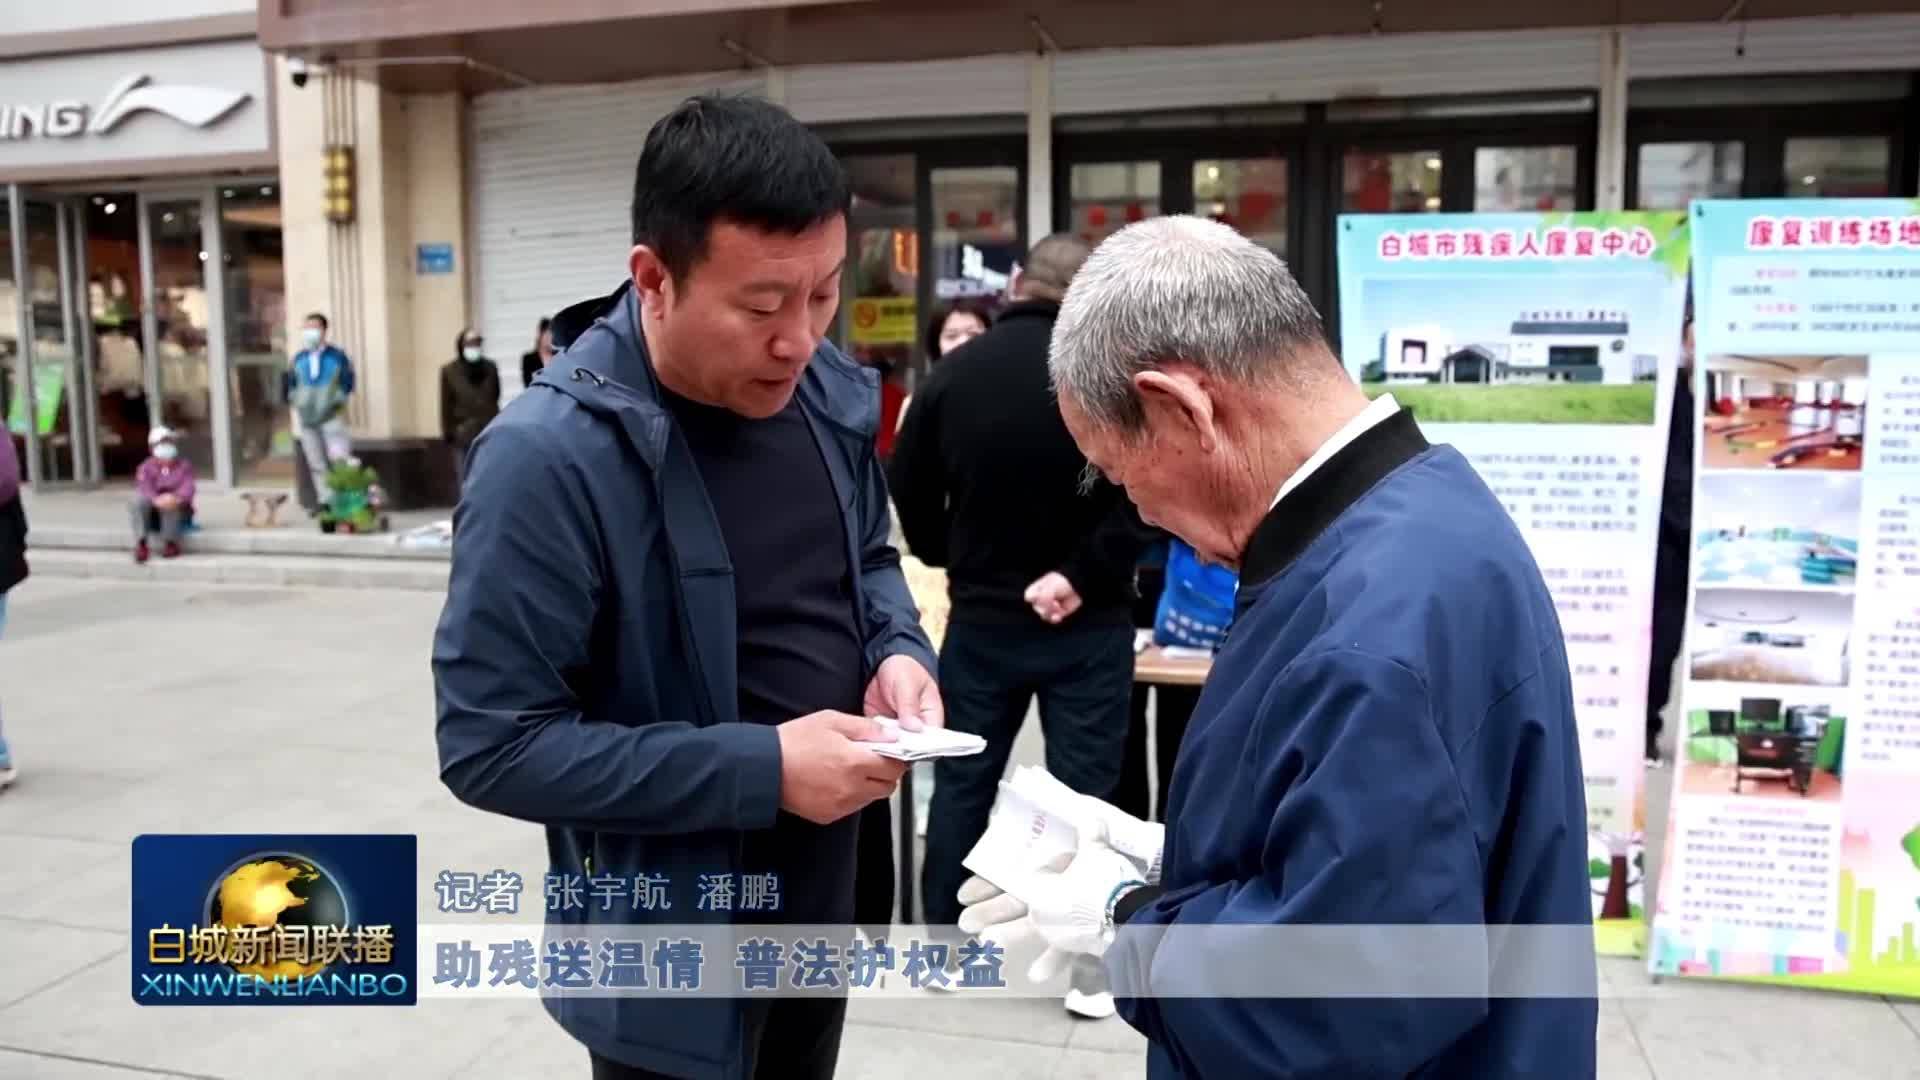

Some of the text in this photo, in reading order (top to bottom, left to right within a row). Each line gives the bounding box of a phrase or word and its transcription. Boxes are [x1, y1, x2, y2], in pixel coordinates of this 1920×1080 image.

[1380, 229, 1654, 259] 白城市残疾人康复中心
[1748, 218, 1920, 247] 康复训练场地
